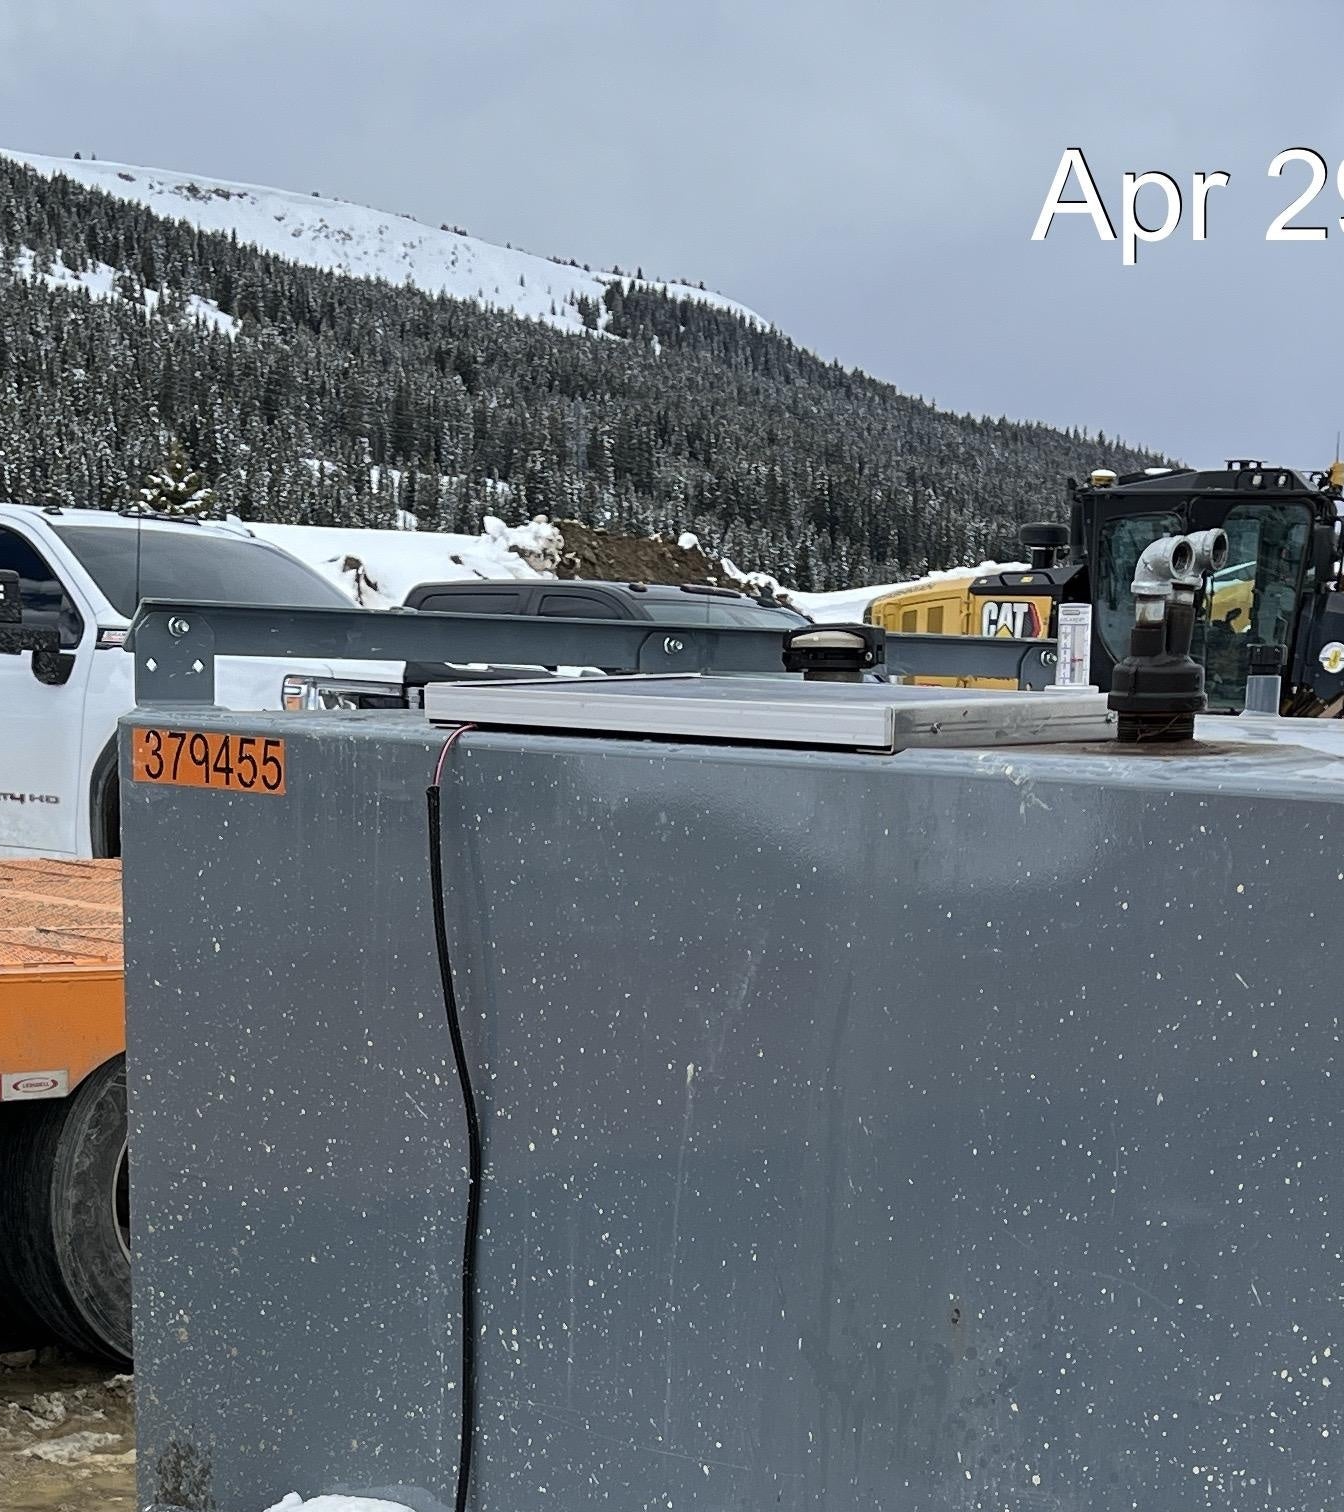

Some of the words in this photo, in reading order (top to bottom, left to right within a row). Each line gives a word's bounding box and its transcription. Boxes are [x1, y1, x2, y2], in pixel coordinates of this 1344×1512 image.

[982, 601, 1029, 638] CAT
[144, 729, 283, 791] 379455
[29, 794, 60, 805] HD
